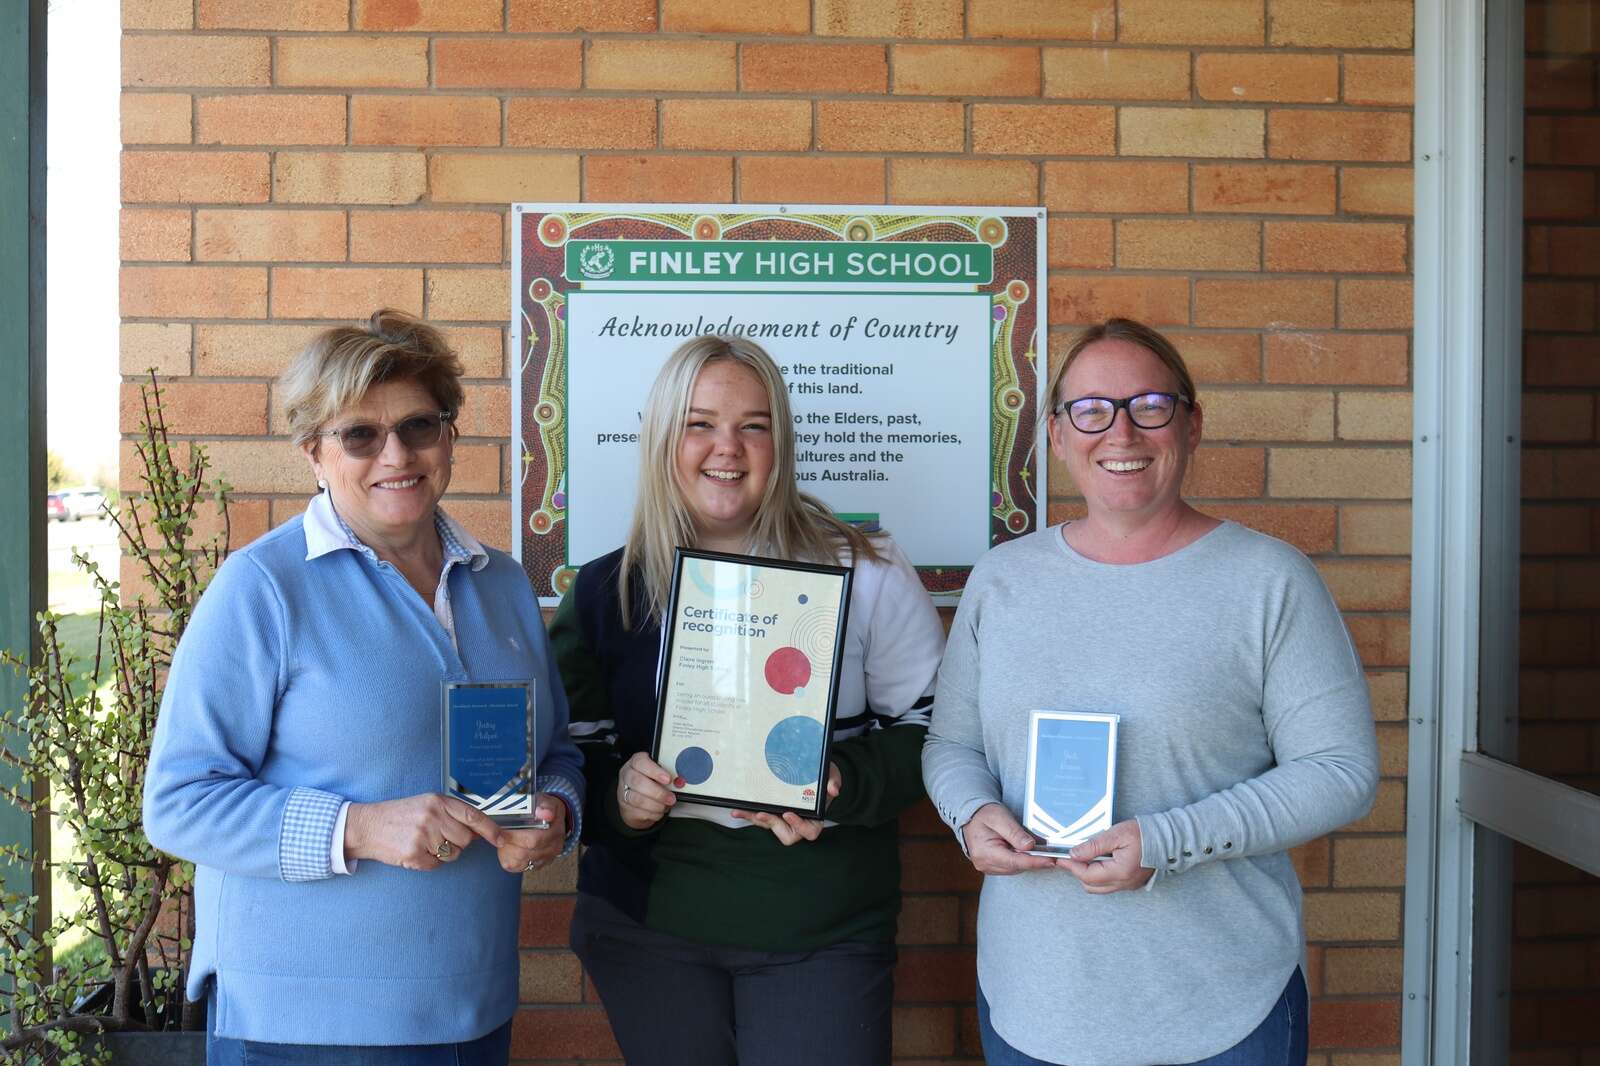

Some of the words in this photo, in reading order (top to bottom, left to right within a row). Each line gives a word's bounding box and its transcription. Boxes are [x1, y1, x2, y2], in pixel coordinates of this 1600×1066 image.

[629, 251, 743, 275] FINLEY
[755, 251, 834, 276] HIGH
[846, 252, 980, 277] SCHOOL
[598, 315, 822, 338] Acknowledgement
[829, 315, 858, 342] of
[864, 317, 959, 345] Country
[792, 362, 817, 376] the
[820, 362, 894, 376] traditional
[797, 382, 824, 394] this
[828, 382, 863, 395] land.
[806, 412, 831, 425] the
[834, 412, 883, 426] Elders,
[887, 413, 922, 428] past,
[597, 433, 641, 446] prese
[824, 431, 856, 444] hold
[859, 431, 884, 444] the
[887, 431, 962, 445] memories,
[796, 450, 846, 463] ultures
[848, 450, 877, 463] and
[879, 450, 904, 463] the
[820, 469, 889, 482] Australia.
[683, 606, 759, 624] Certificate
[762, 613, 778, 625] of
[682, 621, 766, 638] recognition
